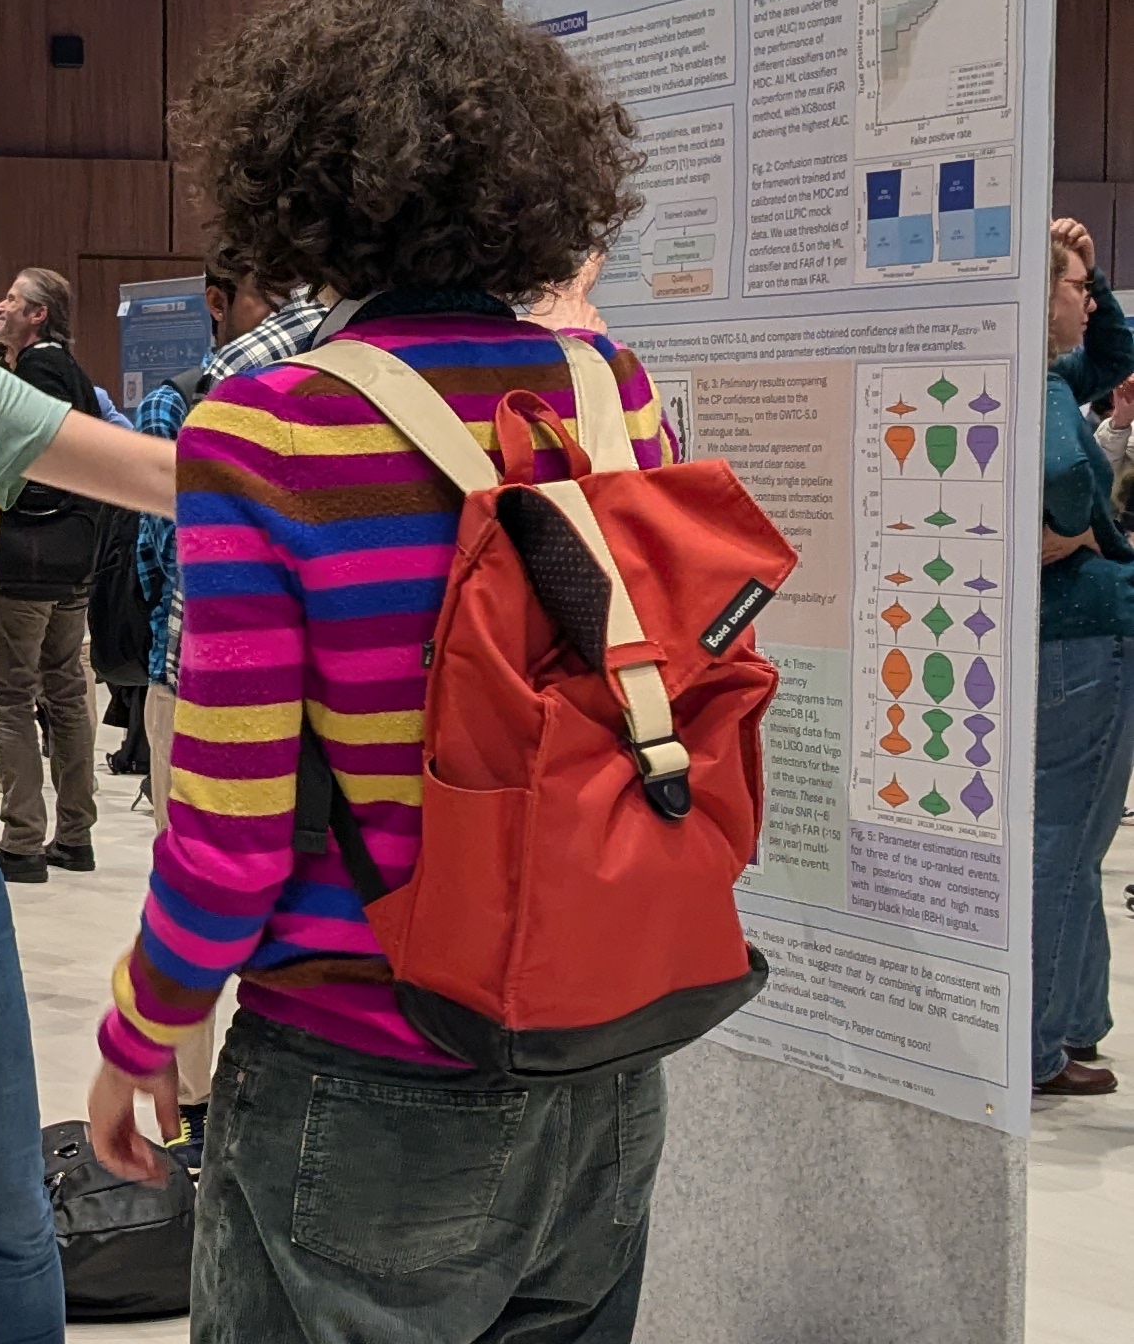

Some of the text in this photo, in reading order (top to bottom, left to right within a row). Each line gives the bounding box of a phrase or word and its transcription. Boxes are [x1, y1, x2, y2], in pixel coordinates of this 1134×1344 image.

[753, 11, 767, 23] and
[769, 6, 781, 19] the
[783, 6, 800, 16] area
[801, 0, 822, 13] under
[753, 46, 848, 73] different classifiers on the
[910, 129, 972, 146] False positive rate
[752, 169, 846, 190] for framework trained and
[751, 187, 849, 207] calibrated on the MDC and
[771, 226, 783, 238] We
[783, 227, 797, 237] use
[798, 223, 838, 236] thresholds
[841, 220, 849, 231] of
[749, 238, 843, 257] confidence 0.5 on the ML
[748, 259, 781, 273] classifier
[783, 259, 798, 270] and
[799, 258, 814, 269] FAR
[816, 257, 825, 267] of
[833, 256, 847, 268] per
[668, 336, 702, 348] framework
[702, 336, 710, 345] to
[710, 332, 749, 346] GWTC-5.0,
[750, 332, 766, 343] and
[767, 331, 802, 344] compare
[804, 328, 815, 340] the
[816, 328, 849, 339] obtained
[850, 325, 898, 338] confidence
[899, 324, 915, 335] with
[916, 323, 930, 334] the
[931, 324, 951, 333] max
[982, 320, 996, 331] We
[697, 393, 808, 405] the CP confidence values to the
[706, 587, 763, 648] bold banana
[770, 722, 840, 740] showing data from
[770, 738, 842, 759] the LIGO and Virgo
[878, 832, 920, 850] Parameter
[922, 841, 968, 859] estimation
[970, 850, 1001, 865] results
[851, 845, 1000, 882] for three of the up-ranked events.
[851, 860, 1000, 902] The posteriors show consistency
[851, 879, 999, 918] with intermediate and high mass
[852, 895, 979, 932] binary black hole (BBH) signals.
[763, 931, 1001, 996] these up-ranked candidates appear to be consistent with
[787, 951, 1000, 1015] This suggests that by combining information from
[769, 964, 999, 1033] pipelines, our framework can find low SNR candidates
[757, 995, 766, 1004] All
[768, 999, 794, 1013] results
[795, 1007, 808, 1016] are
[852, 1020, 874, 1036] Paper
[876, 1029, 905, 1047] coming
[907, 1038, 931, 1052] soon!
